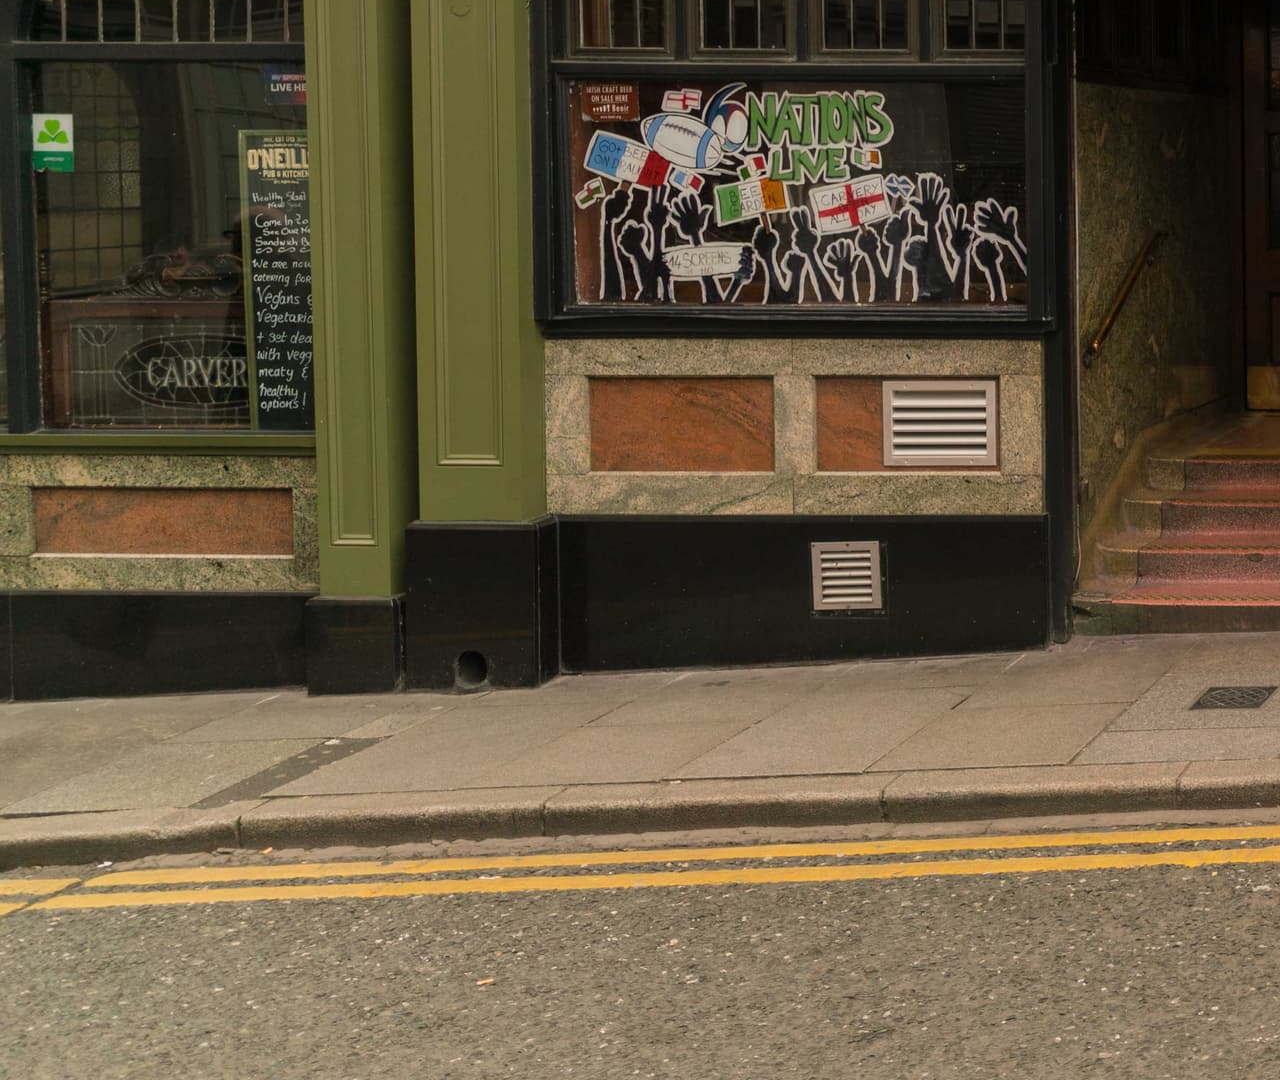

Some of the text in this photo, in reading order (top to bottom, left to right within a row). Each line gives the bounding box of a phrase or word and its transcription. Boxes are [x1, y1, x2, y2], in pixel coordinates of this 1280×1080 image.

[270, 83, 292, 92] LIVE
[619, 85, 633, 93] BEER
[615, 94, 628, 102] HERE
[746, 90, 894, 148] NATIONS
[768, 147, 850, 183] LIVE
[262, 170, 276, 178] PUB
[255, 213, 282, 228] Come
[255, 237, 298, 247] Sandwich
[252, 258, 269, 269] We
[256, 285, 300, 310] Vegans
[257, 347, 280, 361] with
[258, 366, 294, 382] meaty
[259, 382, 299, 400] healthy
